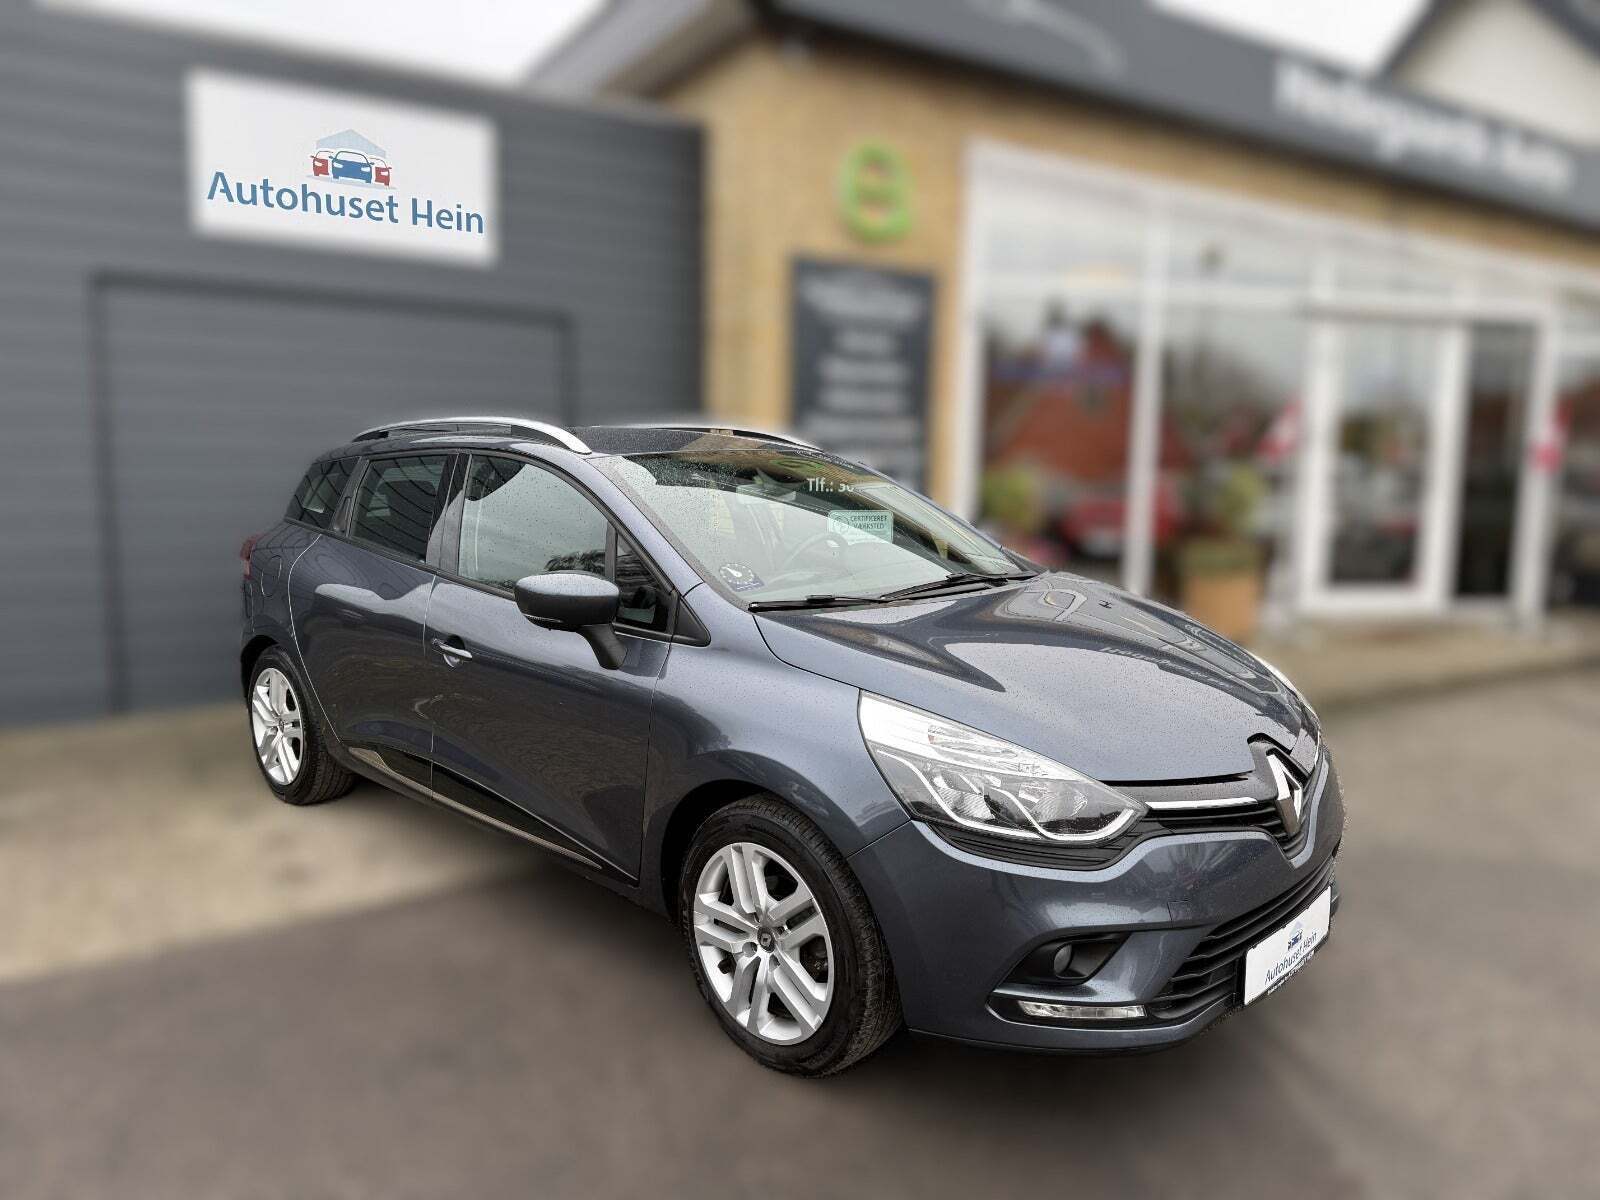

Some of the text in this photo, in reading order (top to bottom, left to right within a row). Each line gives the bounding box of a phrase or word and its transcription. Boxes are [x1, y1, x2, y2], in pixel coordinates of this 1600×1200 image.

[207, 171, 485, 234] Autohuset Hein
[1264, 943, 1302, 985] Autohuset
